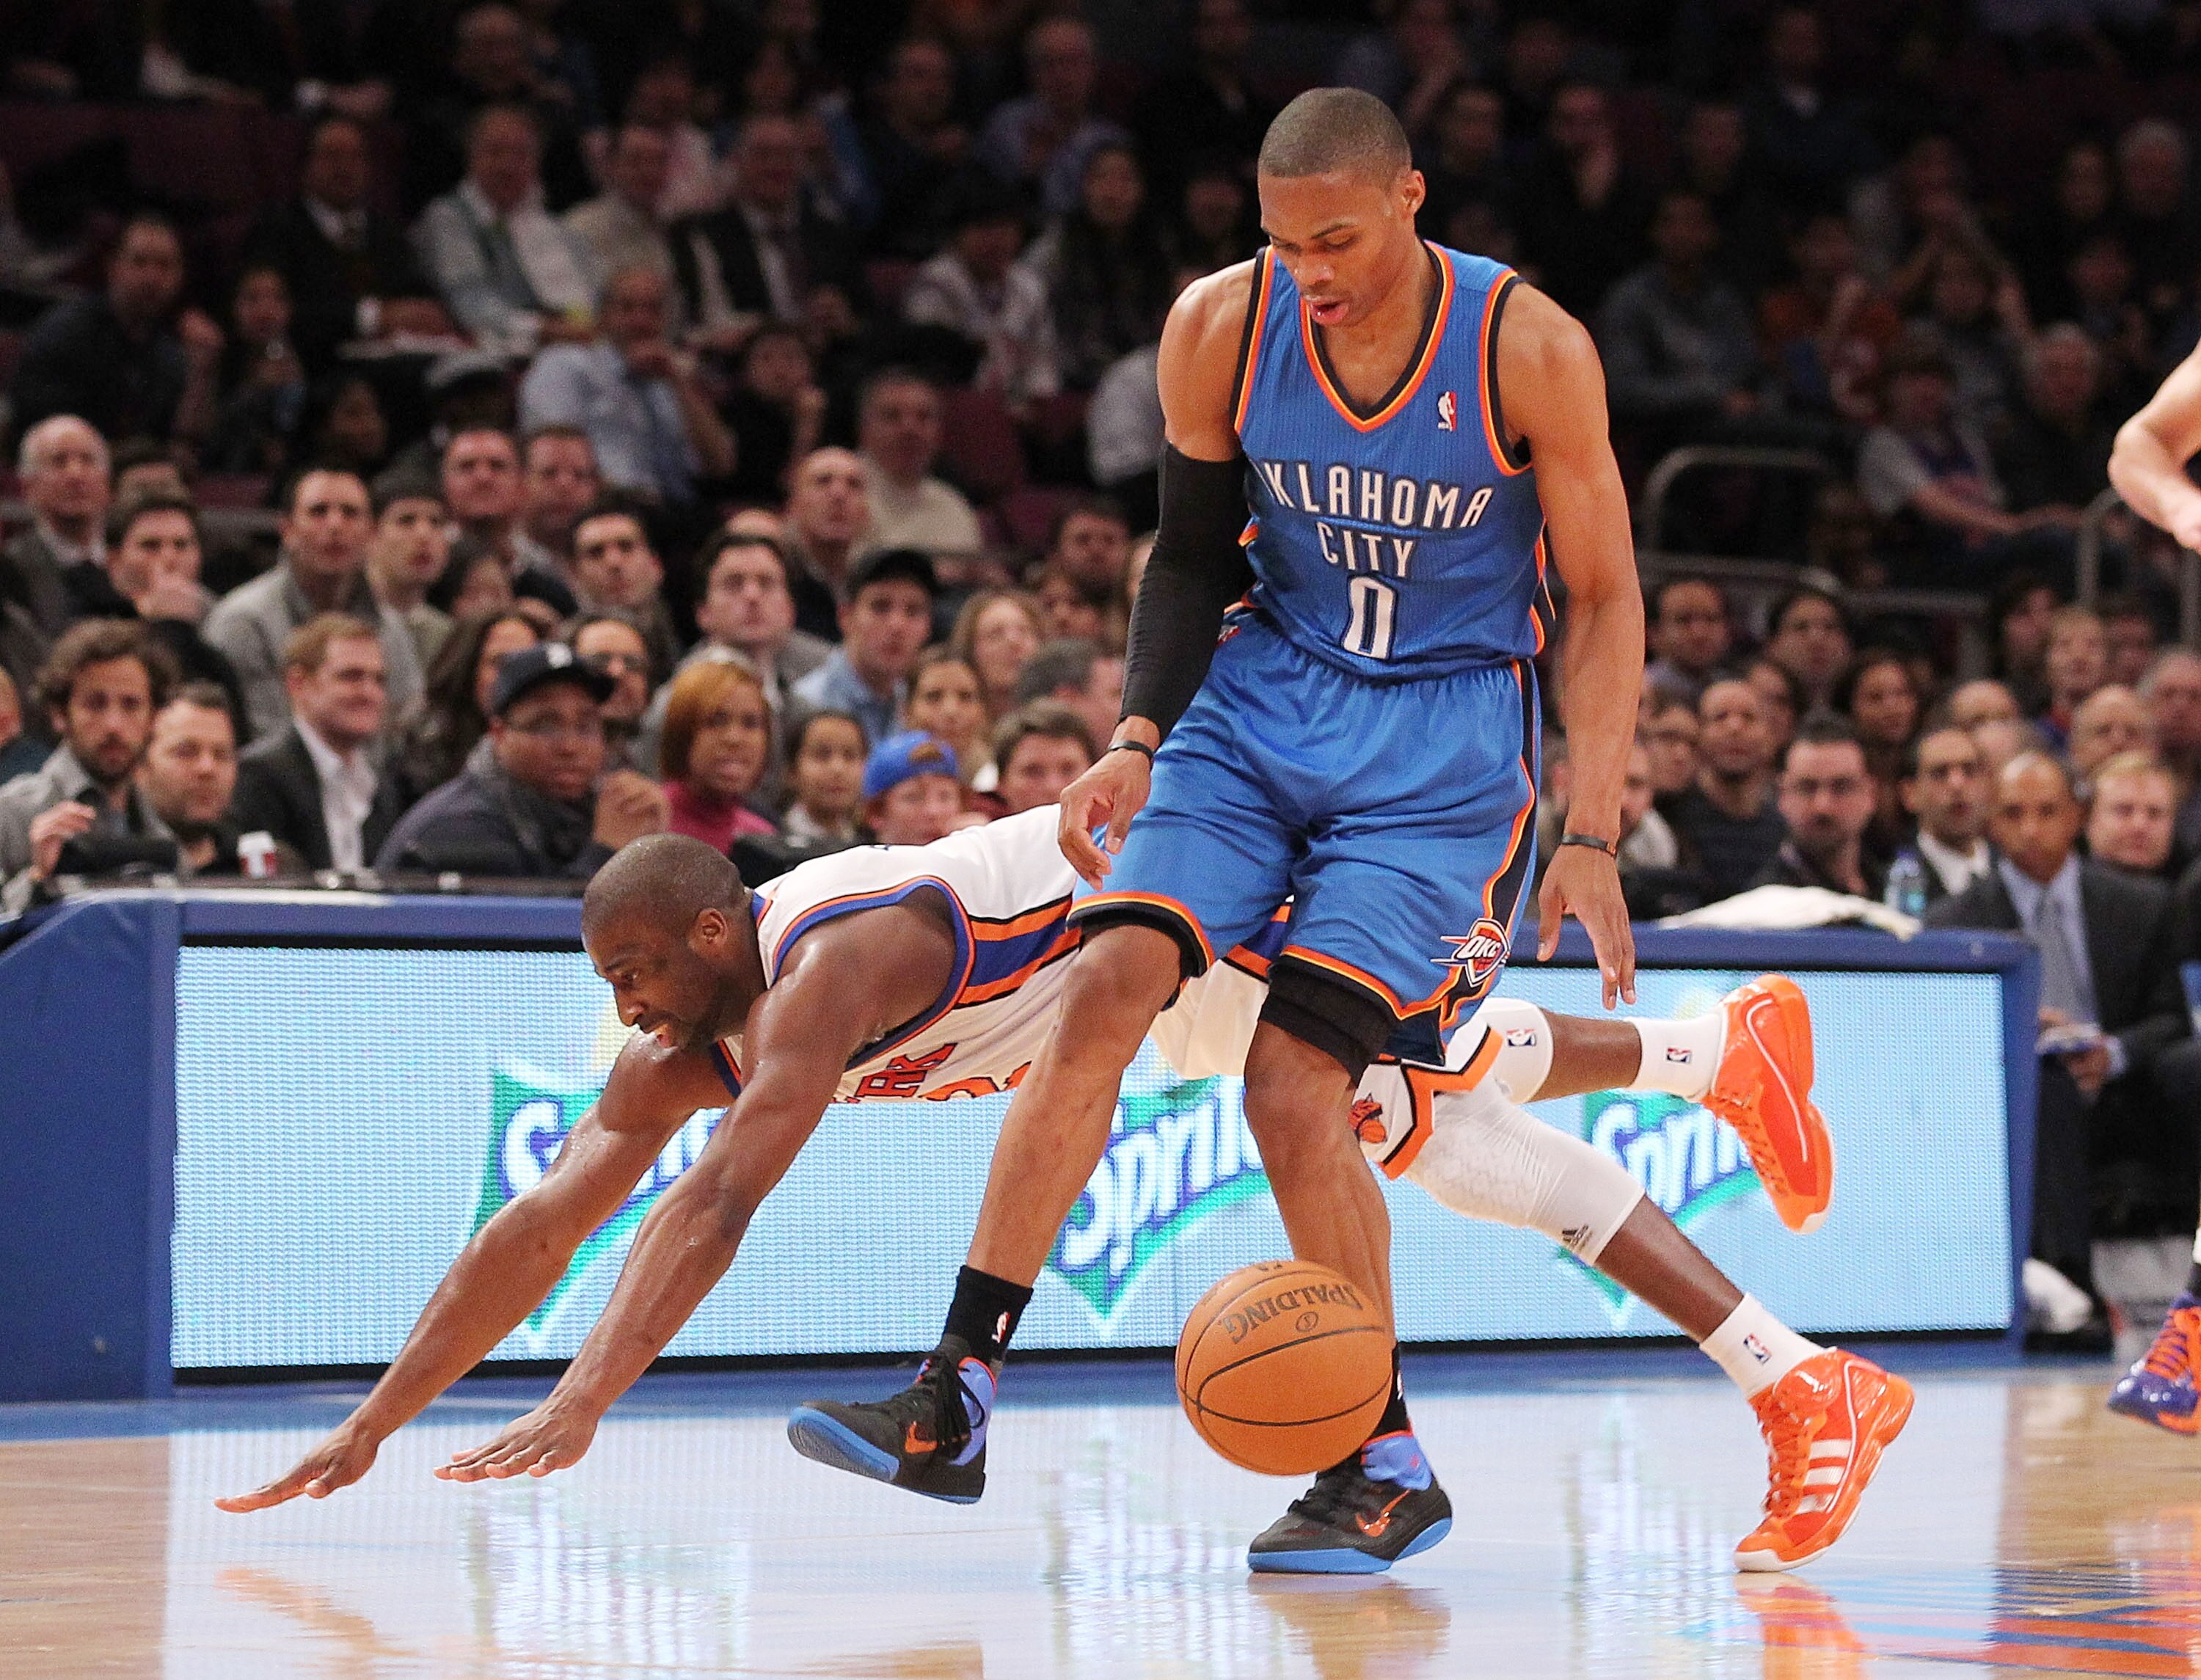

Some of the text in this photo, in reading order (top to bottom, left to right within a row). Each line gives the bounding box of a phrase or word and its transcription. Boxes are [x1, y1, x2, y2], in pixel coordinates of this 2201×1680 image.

[1249, 456, 1494, 530] KLAHOMA
[1316, 522, 1415, 578] CITY
[1341, 574, 1396, 660] 0
[1456, 935, 1502, 960] OKC
